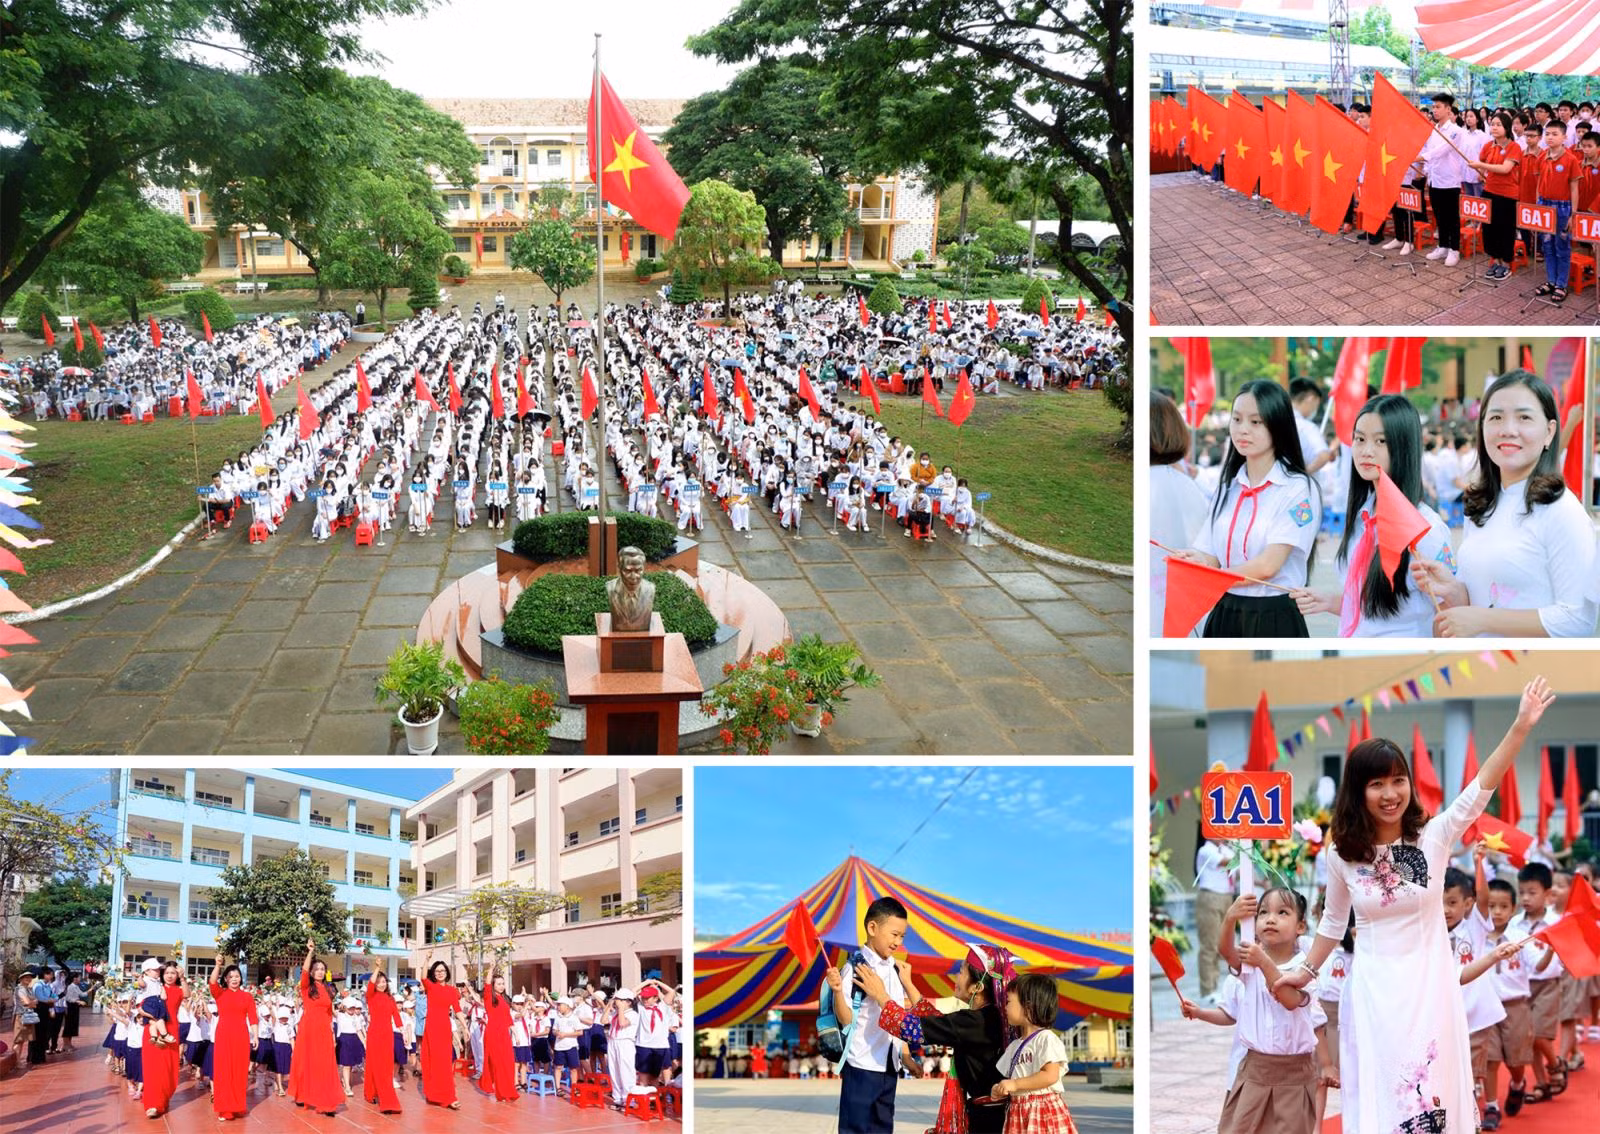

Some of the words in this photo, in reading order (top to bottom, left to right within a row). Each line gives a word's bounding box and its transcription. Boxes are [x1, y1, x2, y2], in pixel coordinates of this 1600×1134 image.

[1400, 191, 1418, 208] 10A1
[1463, 199, 1487, 218] 6A2
[1521, 207, 1551, 228] 6A1
[1208, 784, 1285, 826] 1A1
